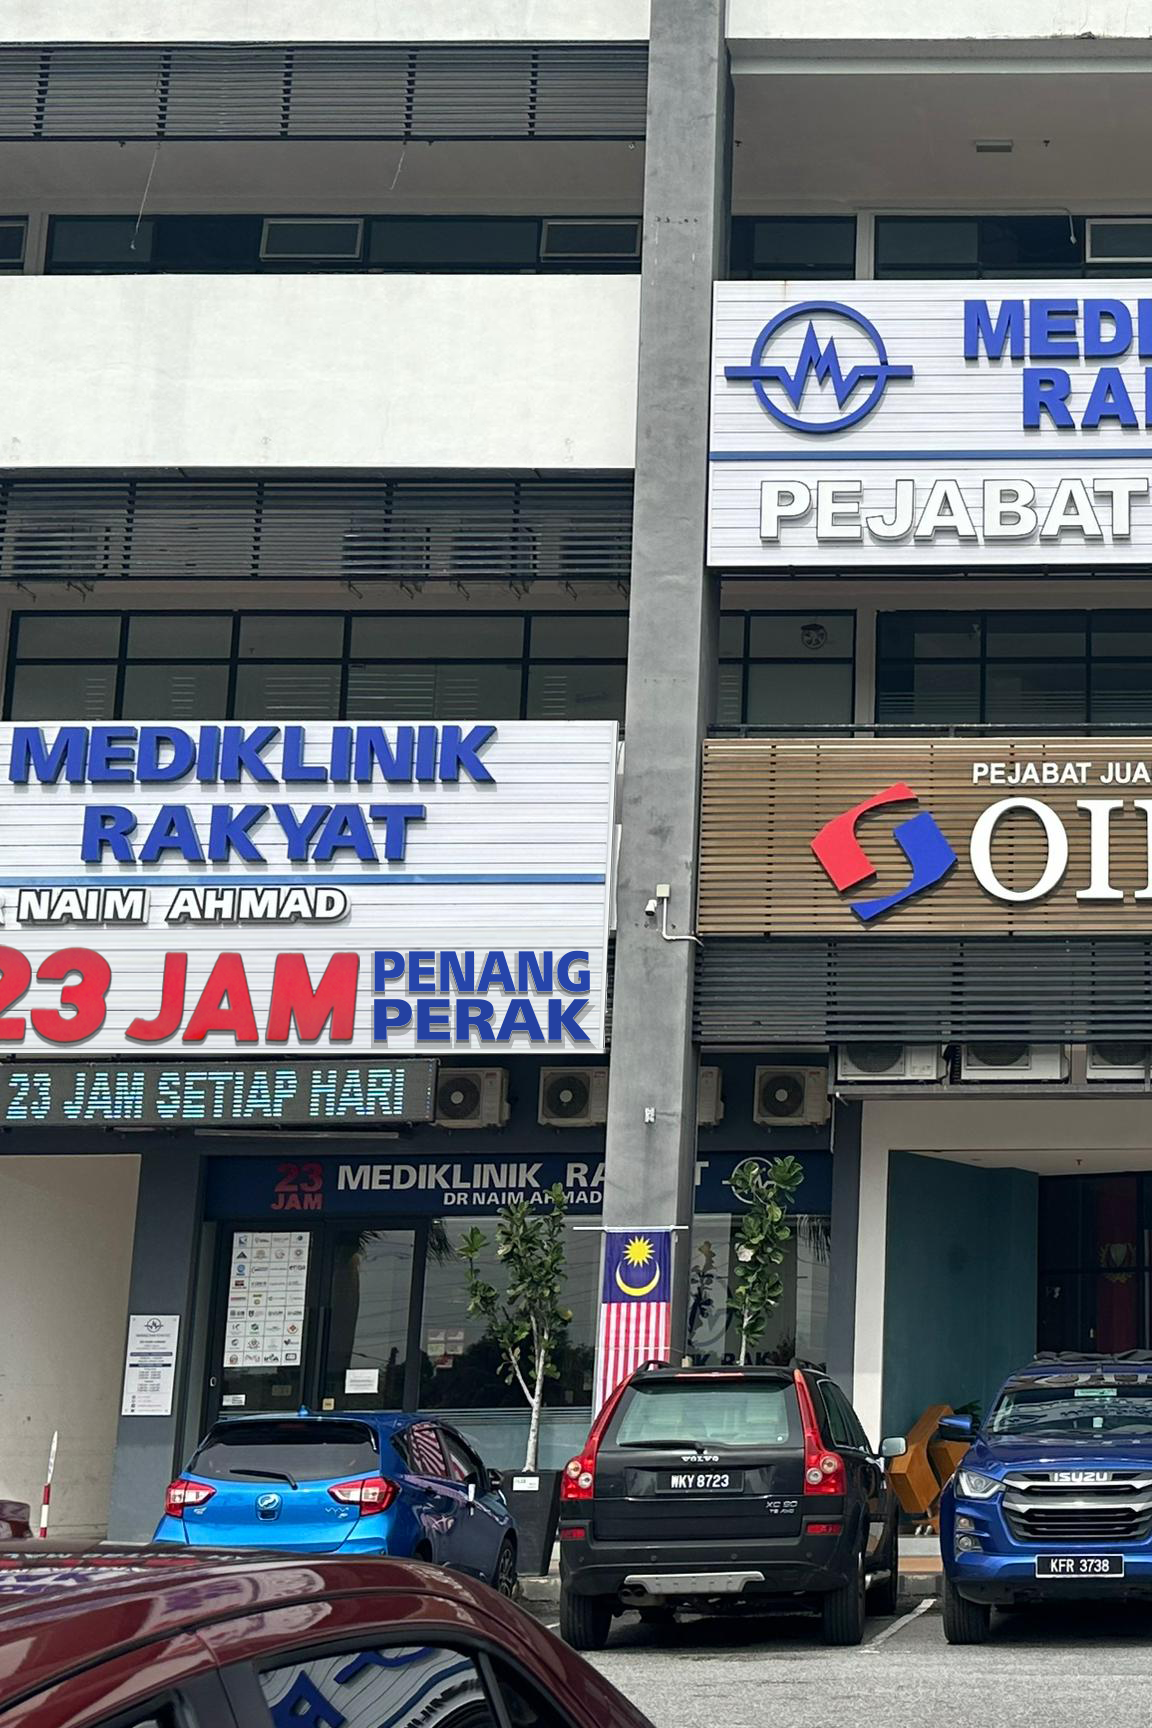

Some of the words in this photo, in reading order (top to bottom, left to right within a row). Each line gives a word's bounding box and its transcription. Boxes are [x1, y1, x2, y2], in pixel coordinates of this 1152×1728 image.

[759, 477, 1149, 542] PEJABAT
[7, 725, 498, 785] MEDIKLINIK
[972, 761, 1093, 785] PEJABAT
[81, 804, 427, 864] RAKYAT
[17, 888, 149, 925] NAIM
[164, 887, 351, 925] AHMAD
[373, 950, 592, 994] PENANG
[124, 951, 360, 1044] JAM
[373, 998, 592, 1043] PERAK
[6, 1072, 53, 1120] 23
[63, 1071, 146, 1119] JAM
[156, 1070, 298, 1118] SETIAP
[308, 1068, 405, 1116] HARI
[275, 1163, 323, 1193] 23
[337, 1162, 544, 1190] MEDIKLINIK
[270, 1193, 323, 1211] JAM
[443, 1190, 468, 1206] DR
[472, 1190, 527, 1206] NAIM
[670, 1475, 695, 1489] WKY
[696, 1474, 730, 1488] 8723
[1053, 1472, 1108, 1483] ISUZU
[1050, 1559, 1075, 1573] KFR
[1079, 1558, 1110, 1572] 3738
